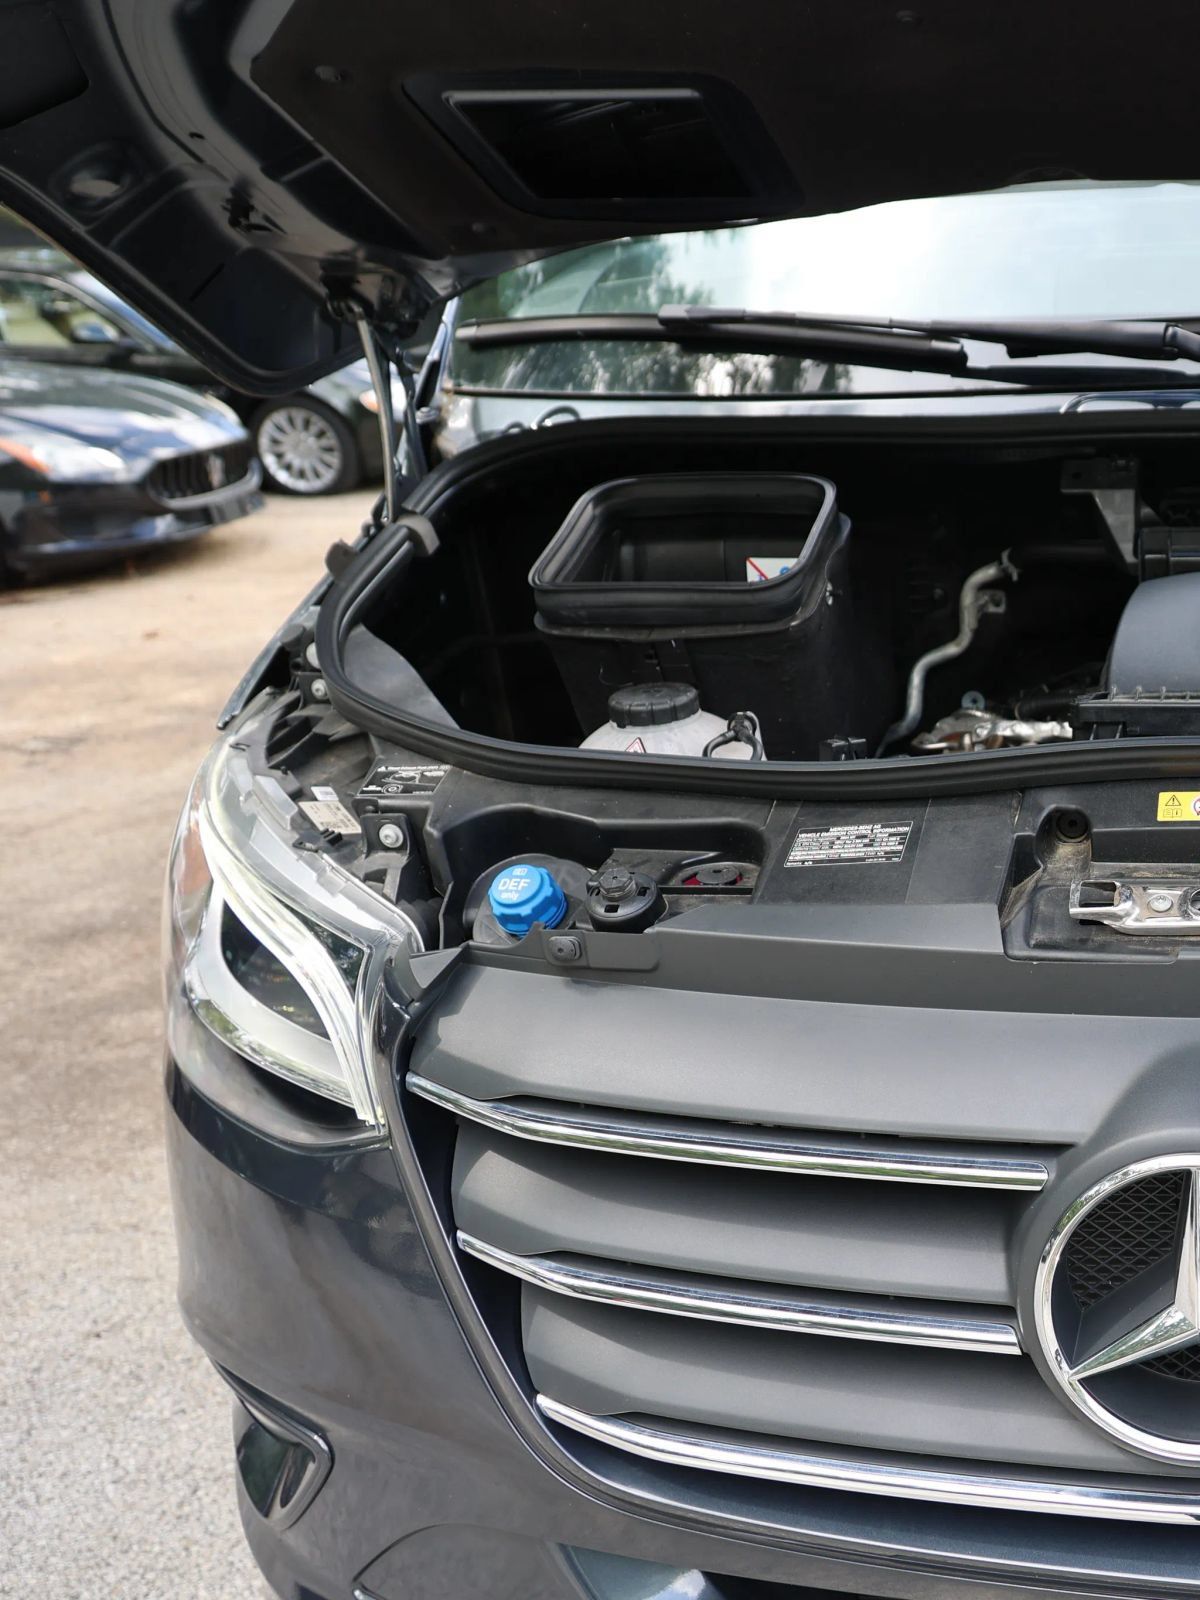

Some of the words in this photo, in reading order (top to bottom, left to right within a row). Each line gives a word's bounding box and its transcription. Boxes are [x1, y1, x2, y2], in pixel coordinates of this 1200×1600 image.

[847, 828, 872, 836] CONTROL
[872, 826, 910, 834] INFORMATION
[498, 879, 530, 890] DEF
